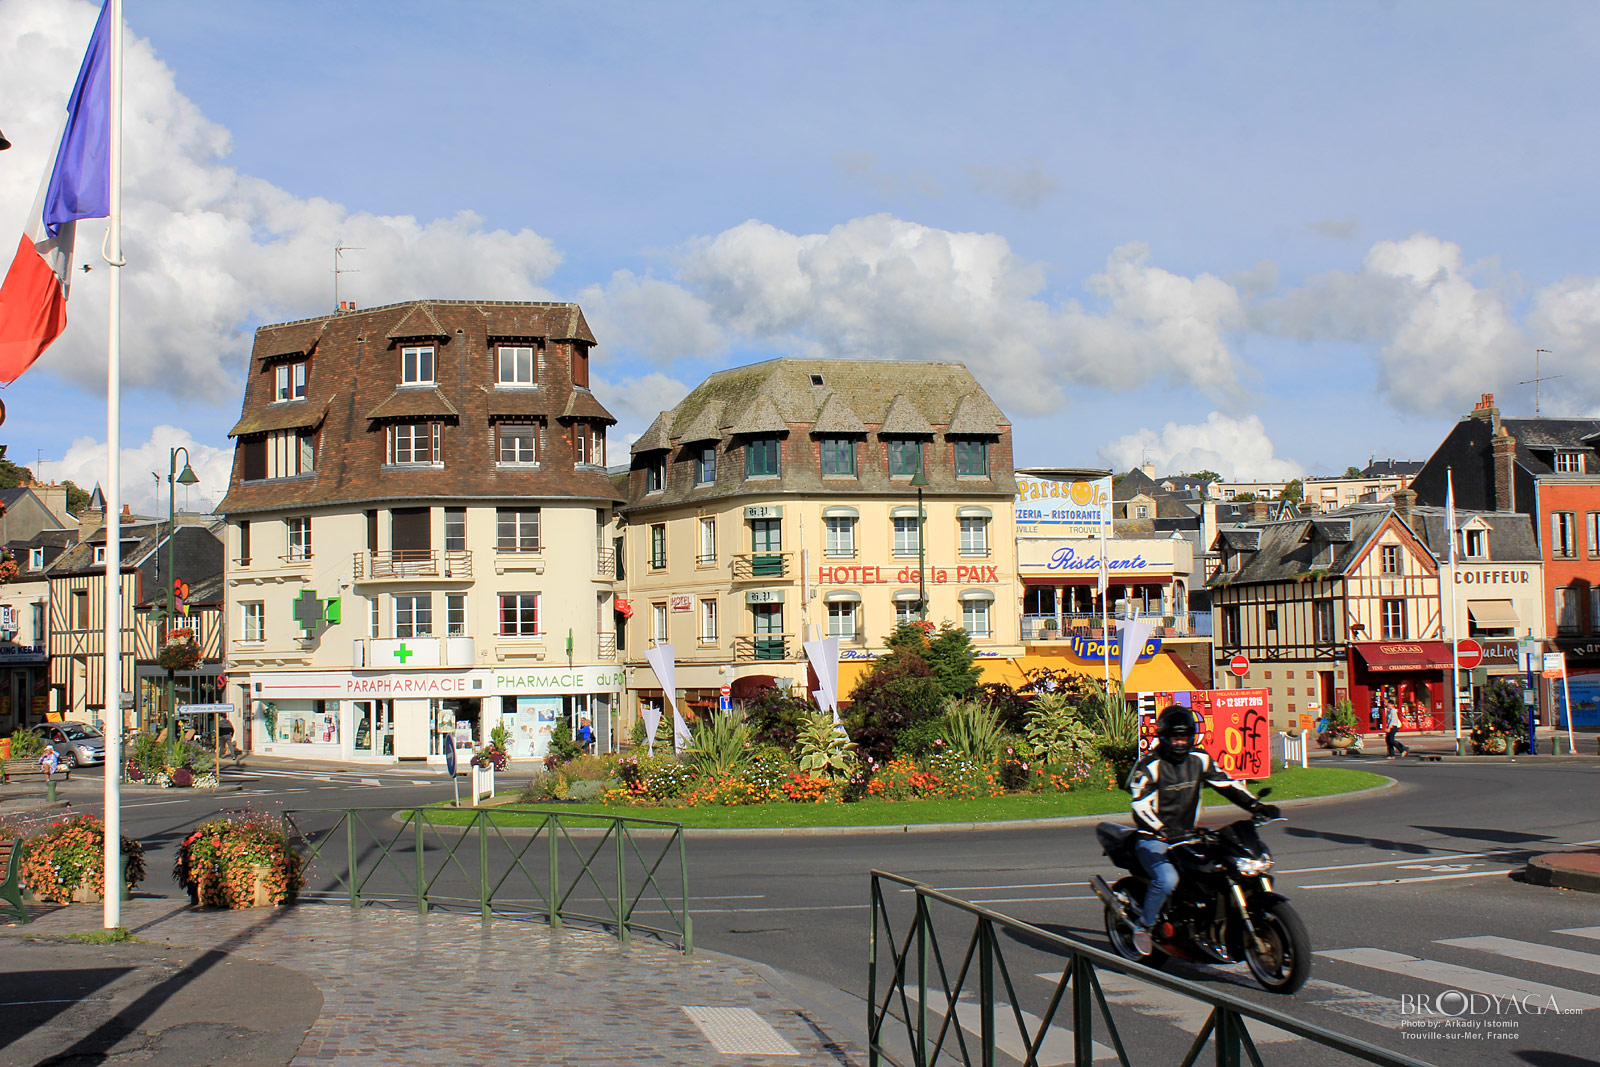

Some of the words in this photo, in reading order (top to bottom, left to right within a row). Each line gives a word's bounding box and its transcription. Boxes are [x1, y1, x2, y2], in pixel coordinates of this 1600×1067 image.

[1052, 510, 1101, 520] RISTORANTE
[1047, 547, 1148, 570] Ristoante
[818, 565, 888, 584] HOTEL
[897, 565, 921, 584] de
[931, 565, 948, 584] la
[956, 565, 999, 584] PAIX
[1454, 571, 1530, 584] COIFFEUR
[671, 596, 691, 605] HOTEL
[1086, 641, 1155, 656] Parale
[347, 678, 465, 693] PARAPHARMACIE
[497, 674, 584, 688] PHARMACIE
[596, 673, 611, 686] du
[1216, 698, 1221, 708] 4
[1226, 698, 1234, 707] 12
[1233, 697, 1248, 707] SEPT
[1248, 696, 1263, 707] 2015
